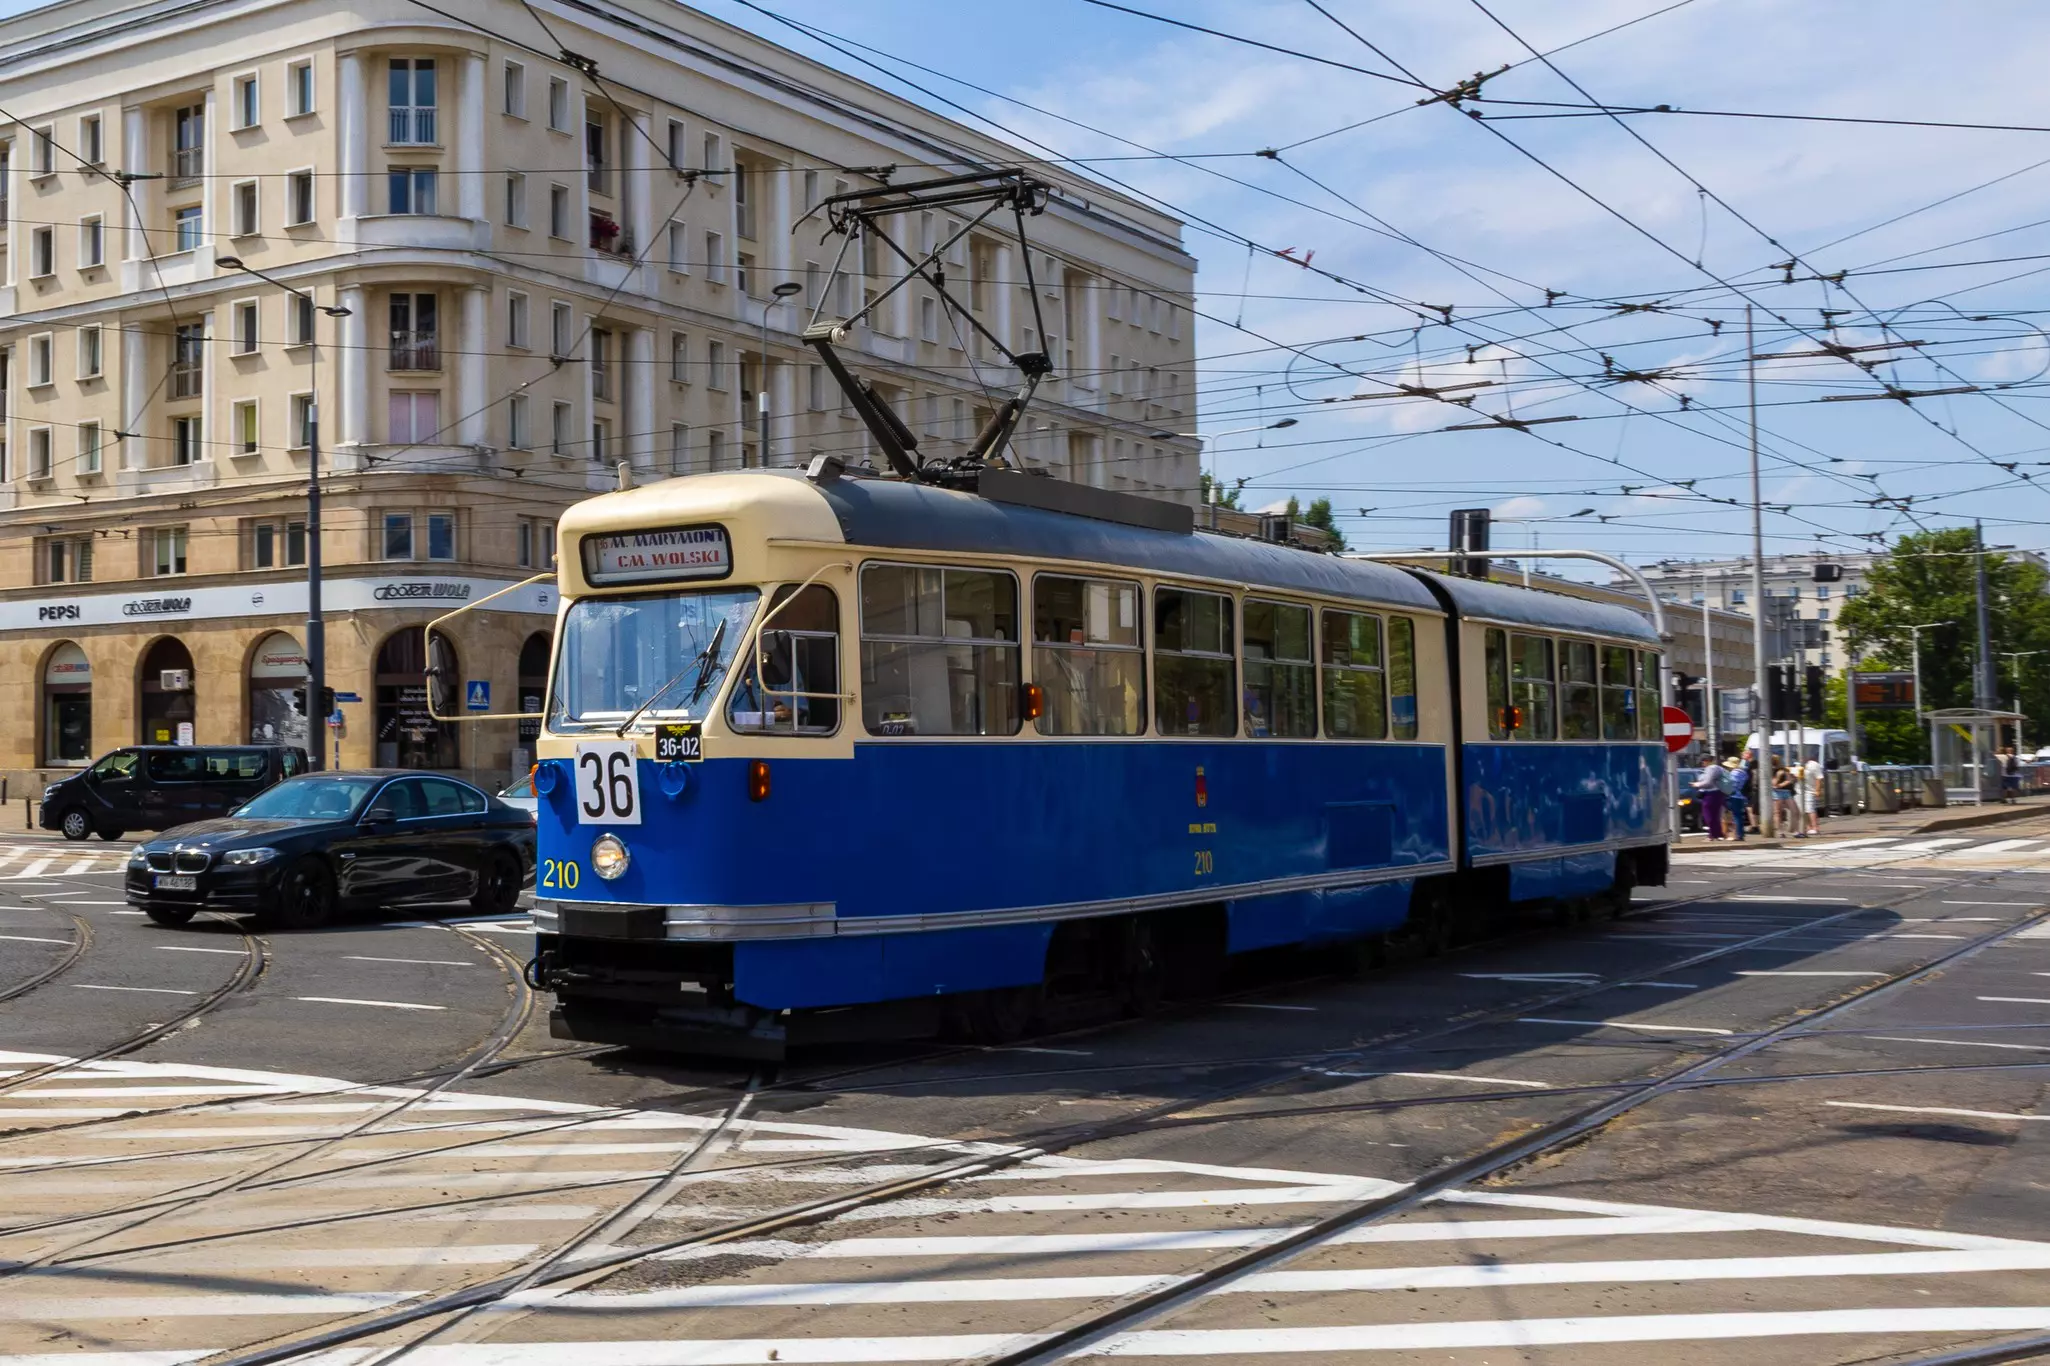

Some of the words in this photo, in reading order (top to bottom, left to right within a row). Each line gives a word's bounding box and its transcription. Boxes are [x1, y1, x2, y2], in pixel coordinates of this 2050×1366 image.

[633, 529, 723, 548] MARYMONT
[651, 549, 720, 567] WOLSKI
[432, 583, 471, 597] WOLA
[39, 605, 80, 620] PEPSI
[162, 597, 192, 611] WOLA
[659, 737, 700, 756] 36-02
[580, 751, 634, 818] 36
[1194, 850, 1213, 875] 210
[543, 859, 580, 889] 210
